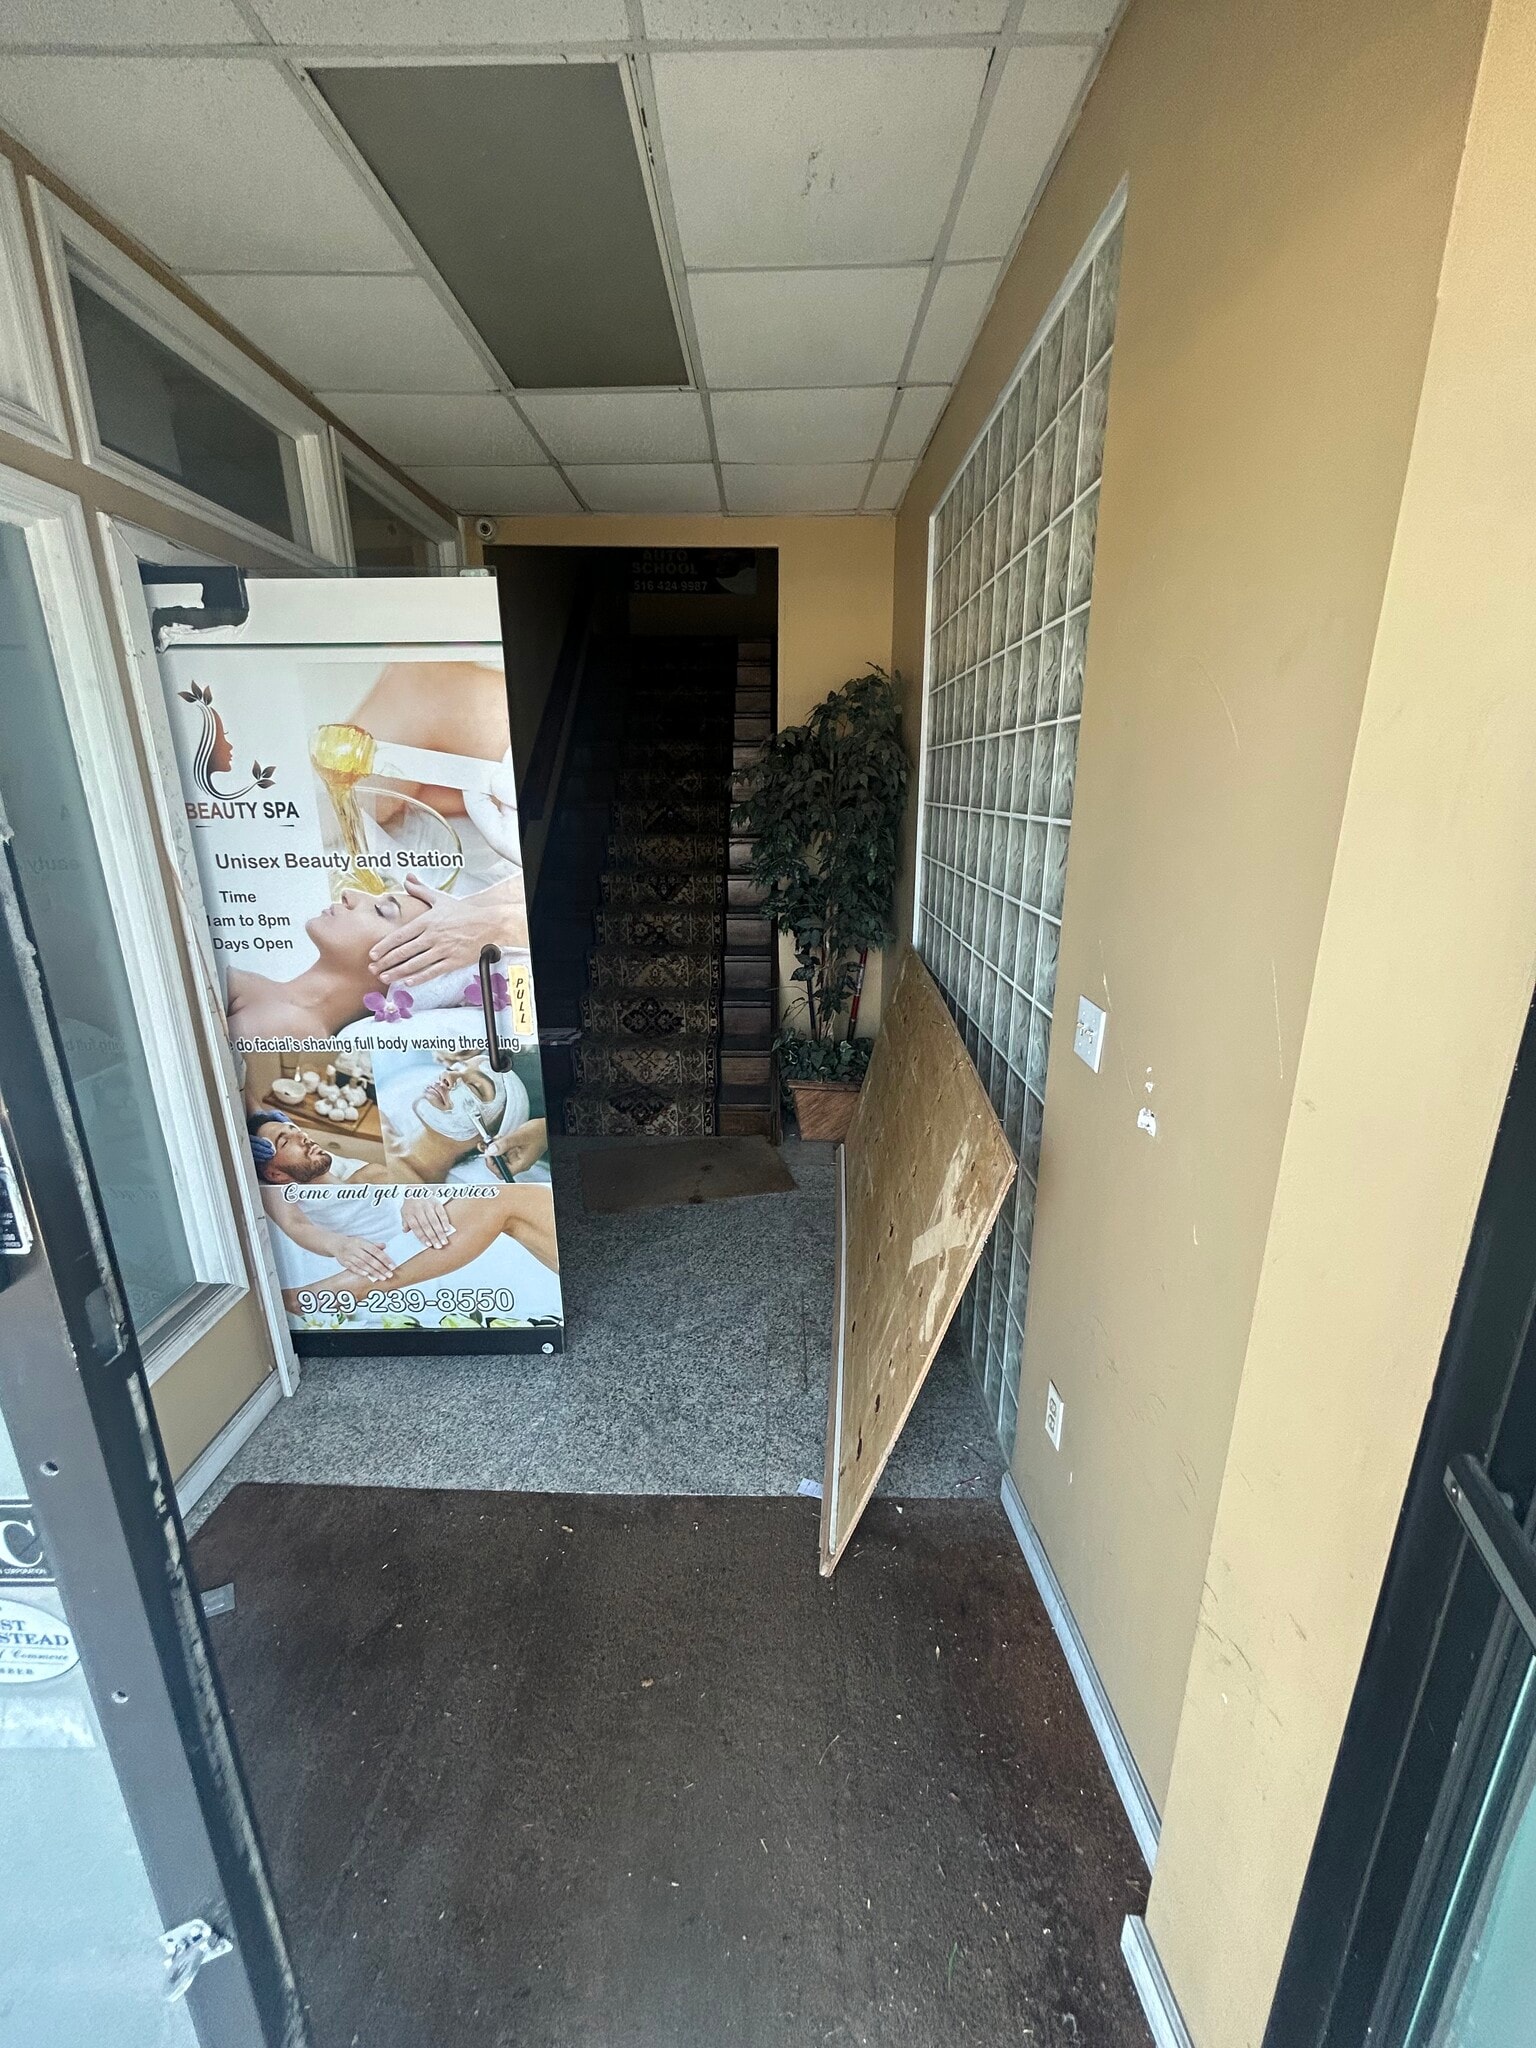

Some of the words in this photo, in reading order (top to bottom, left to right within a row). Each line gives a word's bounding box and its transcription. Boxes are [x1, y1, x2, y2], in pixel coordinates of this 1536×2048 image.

[642, 549, 689, 561] AUTO
[632, 561, 699, 575] SCHOOL
[633, 580, 655, 591] 516
[657, 580, 678, 591] 424
[185, 801, 258, 820] BEAUTY
[263, 801, 300, 819] SPA
[215, 853, 280, 869] Unisex
[285, 853, 351, 871] Beauty
[357, 851, 392, 868] and
[397, 851, 464, 868] Station
[219, 890, 257, 903] Time
[239, 914, 254, 927] to
[258, 914, 291, 929] 8pm
[213, 937, 250, 952] Days
[253, 937, 294, 952] Open
[515, 977, 526, 1024] PULL
[236, 1037, 252, 1050] do
[255, 1037, 300, 1051] facial's
[303, 1036, 351, 1053] shaving
[354, 1036, 375, 1050] full
[377, 1036, 408, 1053] body
[411, 1036, 456, 1052] waxing
[459, 1035, 519, 1052] threaing
[282, 1183, 331, 1202] Come
[337, 1184, 369, 1199] and
[373, 1185, 399, 1207] get
[404, 1186, 432, 1199] our
[437, 1185, 498, 1199] services
[297, 1287, 515, 1314] 929-239-8550
